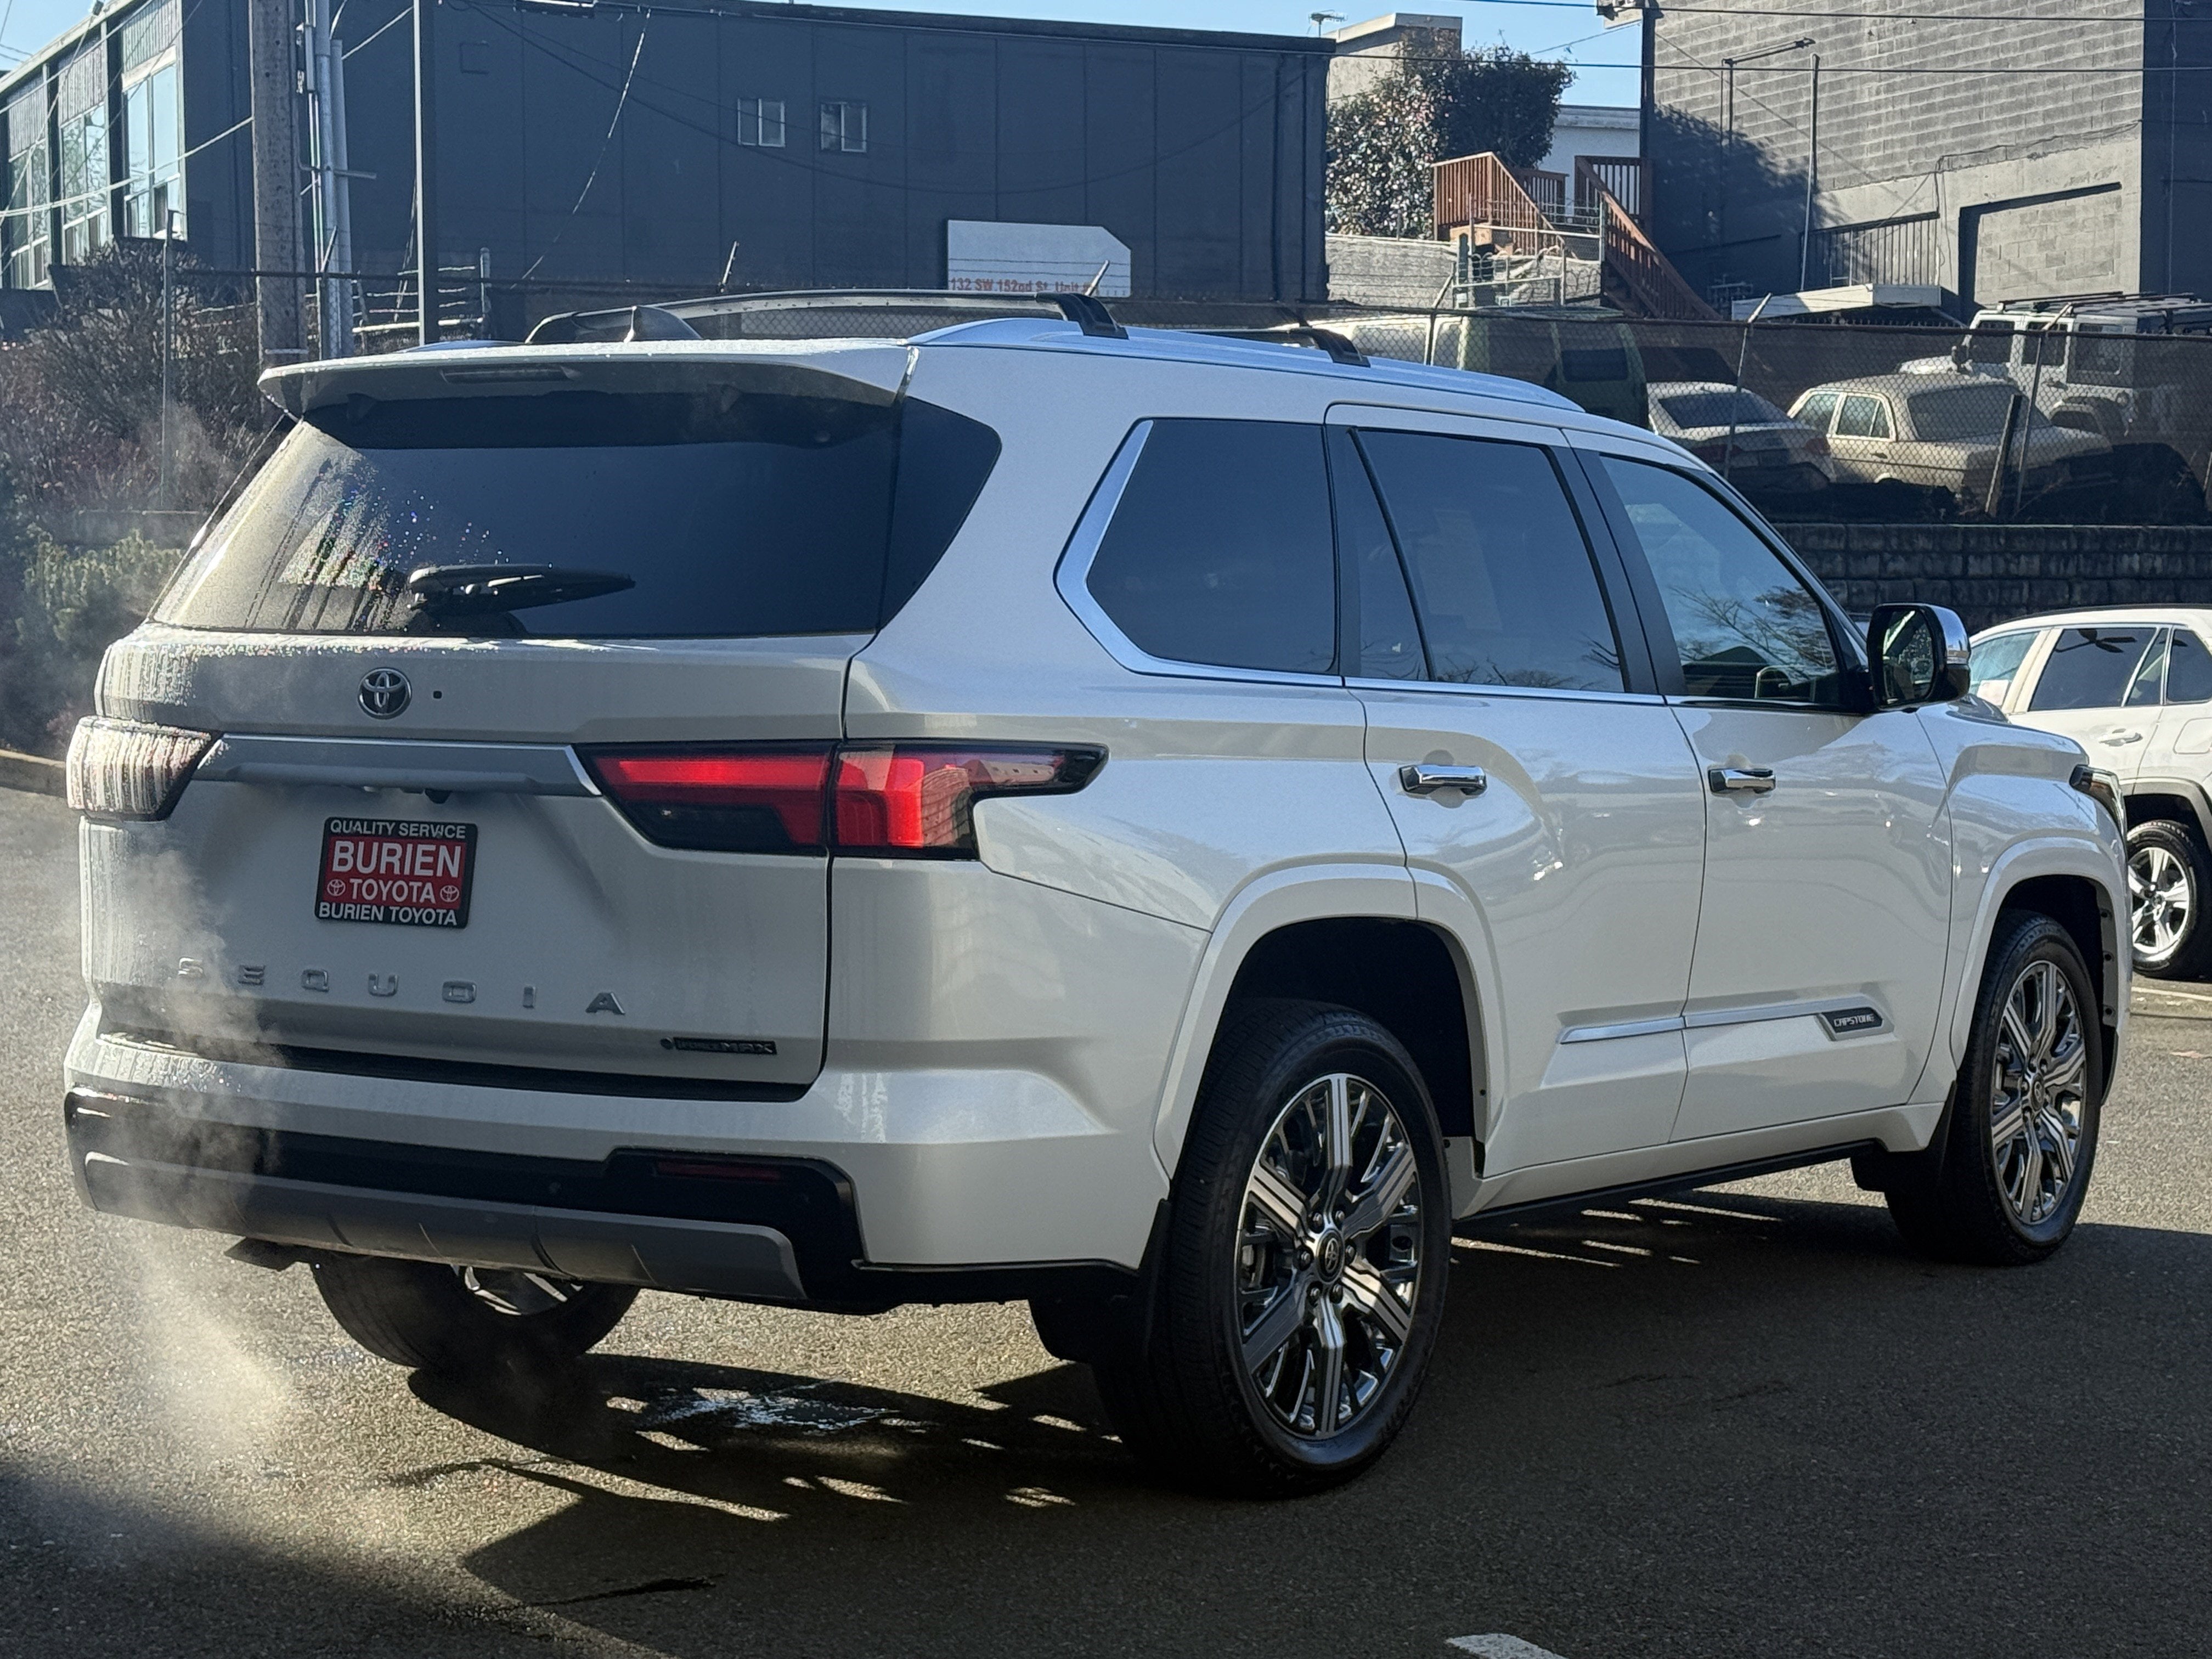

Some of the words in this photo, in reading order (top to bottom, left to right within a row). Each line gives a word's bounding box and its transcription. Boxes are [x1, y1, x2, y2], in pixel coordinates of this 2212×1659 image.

[951, 277, 972, 291] 132
[997, 279, 1032, 292] 152nd
[330, 820, 395, 835] QUALITY
[398, 823, 466, 839] SERVICE
[332, 840, 461, 878] BURIEN
[349, 878, 436, 904] TOYOTA
[319, 902, 385, 921] BURIEN
[389, 906, 457, 926] TOYOTA
[177, 956, 626, 1015] SEQUOIA
[1833, 1013, 1875, 1027] CAPSTONE
